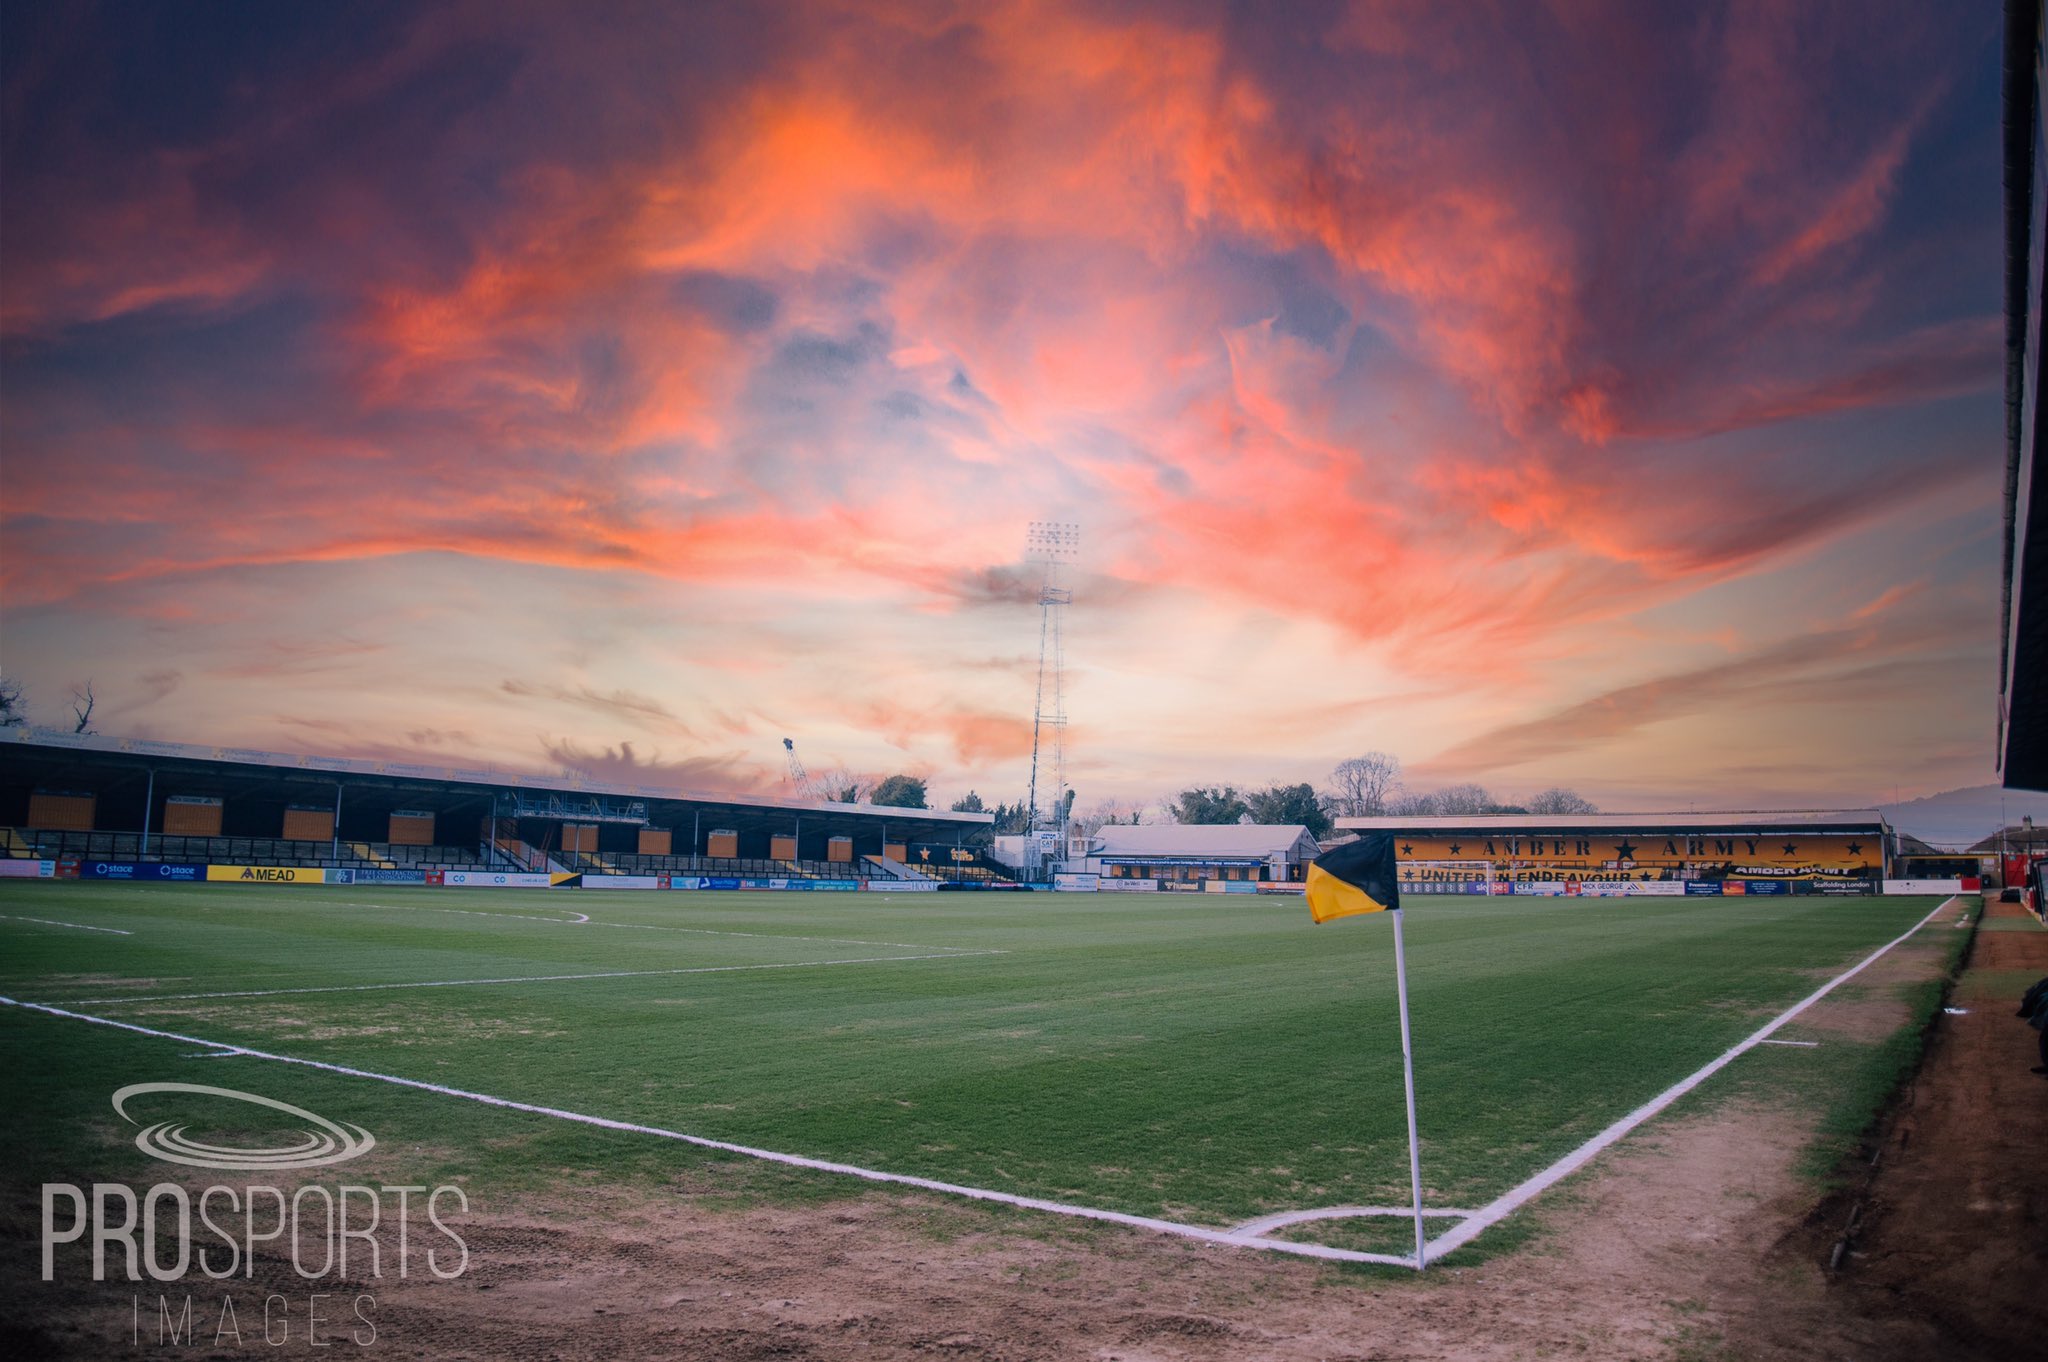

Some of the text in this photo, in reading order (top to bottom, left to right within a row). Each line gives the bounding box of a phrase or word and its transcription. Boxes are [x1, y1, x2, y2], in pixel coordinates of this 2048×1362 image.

[1482, 839, 1760, 856] AMBER ARMY
[108, 864, 134, 873] stace
[171, 866, 195, 875] stace
[256, 869, 295, 881] MEAD
[1420, 869, 1485, 882] UNITED
[1813, 881, 1847, 891] Scaffolding
